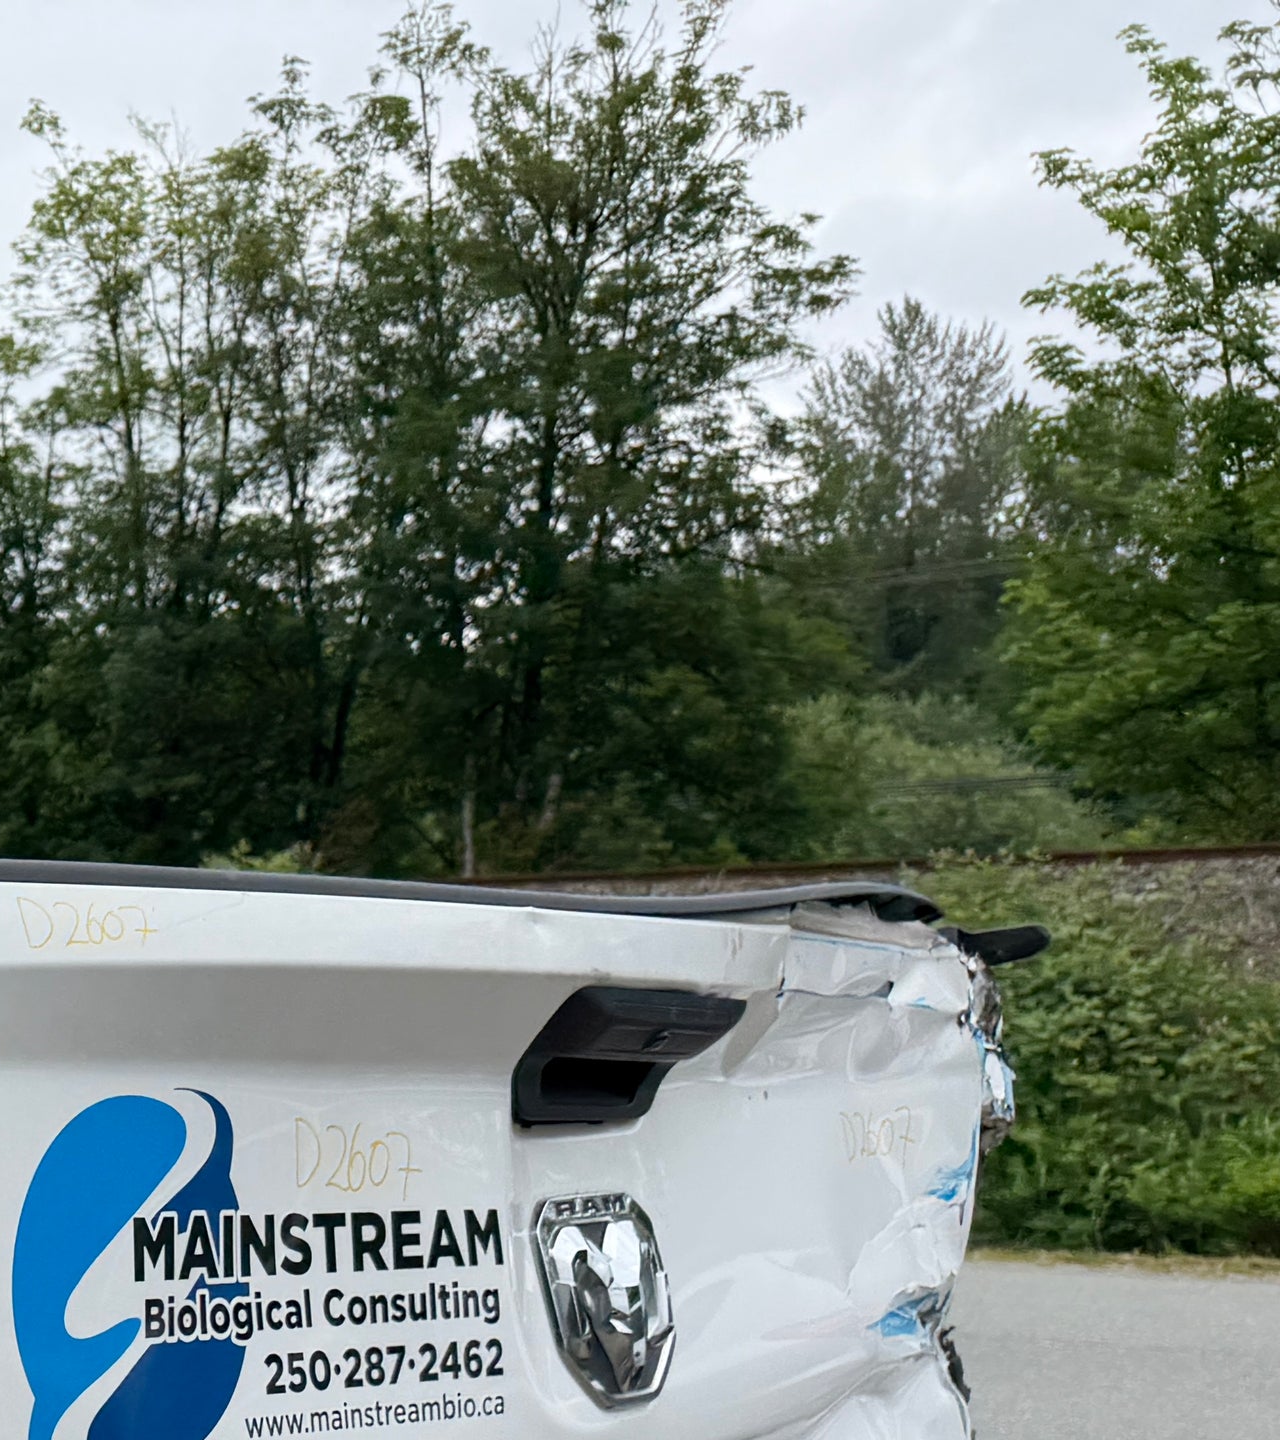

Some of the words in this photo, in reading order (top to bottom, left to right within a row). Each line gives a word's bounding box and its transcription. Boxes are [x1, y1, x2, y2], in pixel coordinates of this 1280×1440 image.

[17, 897, 158, 949] D2607
[295, 1117, 423, 1201] D2607
[555, 1196, 631, 1219] RAM
[133, 1209, 504, 1282] MAINSTREAM
[144, 1289, 312, 1341] Biological
[324, 1283, 500, 1328] Consulting
[245, 1393, 505, 1439] www.mainstreambio.ca
